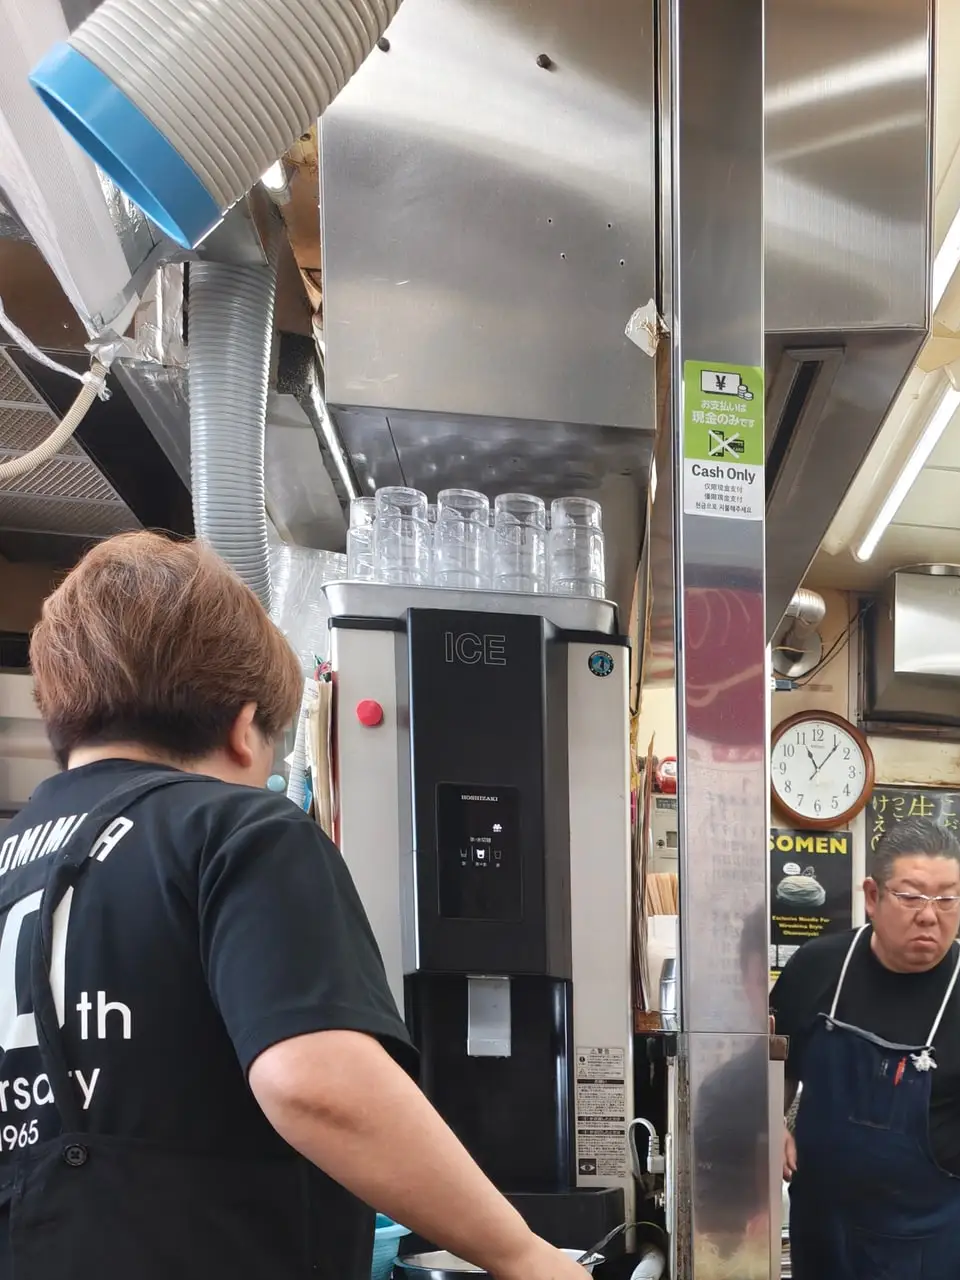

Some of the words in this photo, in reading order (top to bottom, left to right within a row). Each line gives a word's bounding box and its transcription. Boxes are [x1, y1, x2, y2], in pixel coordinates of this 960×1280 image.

[701, 400, 747, 413] お支払いは
[692, 410, 755, 428] 現金のみです
[692, 464, 724, 479] Cash
[727, 467, 756, 485] Only
[445, 632, 506, 666] ICE
[796, 732, 806, 745] 11
[812, 728, 824, 741] 12
[783, 744, 795, 757] 10
[843, 747, 851, 760] 2
[779, 762, 787, 775] 9
[848, 765, 856, 779] 3
[784, 781, 792, 793] 8
[842, 784, 851, 796] 4
[797, 794, 804, 806] 7
[814, 799, 821, 813] 6
[831, 796, 838, 809] 5
[908, 795, 935, 816] 生
[0, 1068, 100, 1112] rsay
